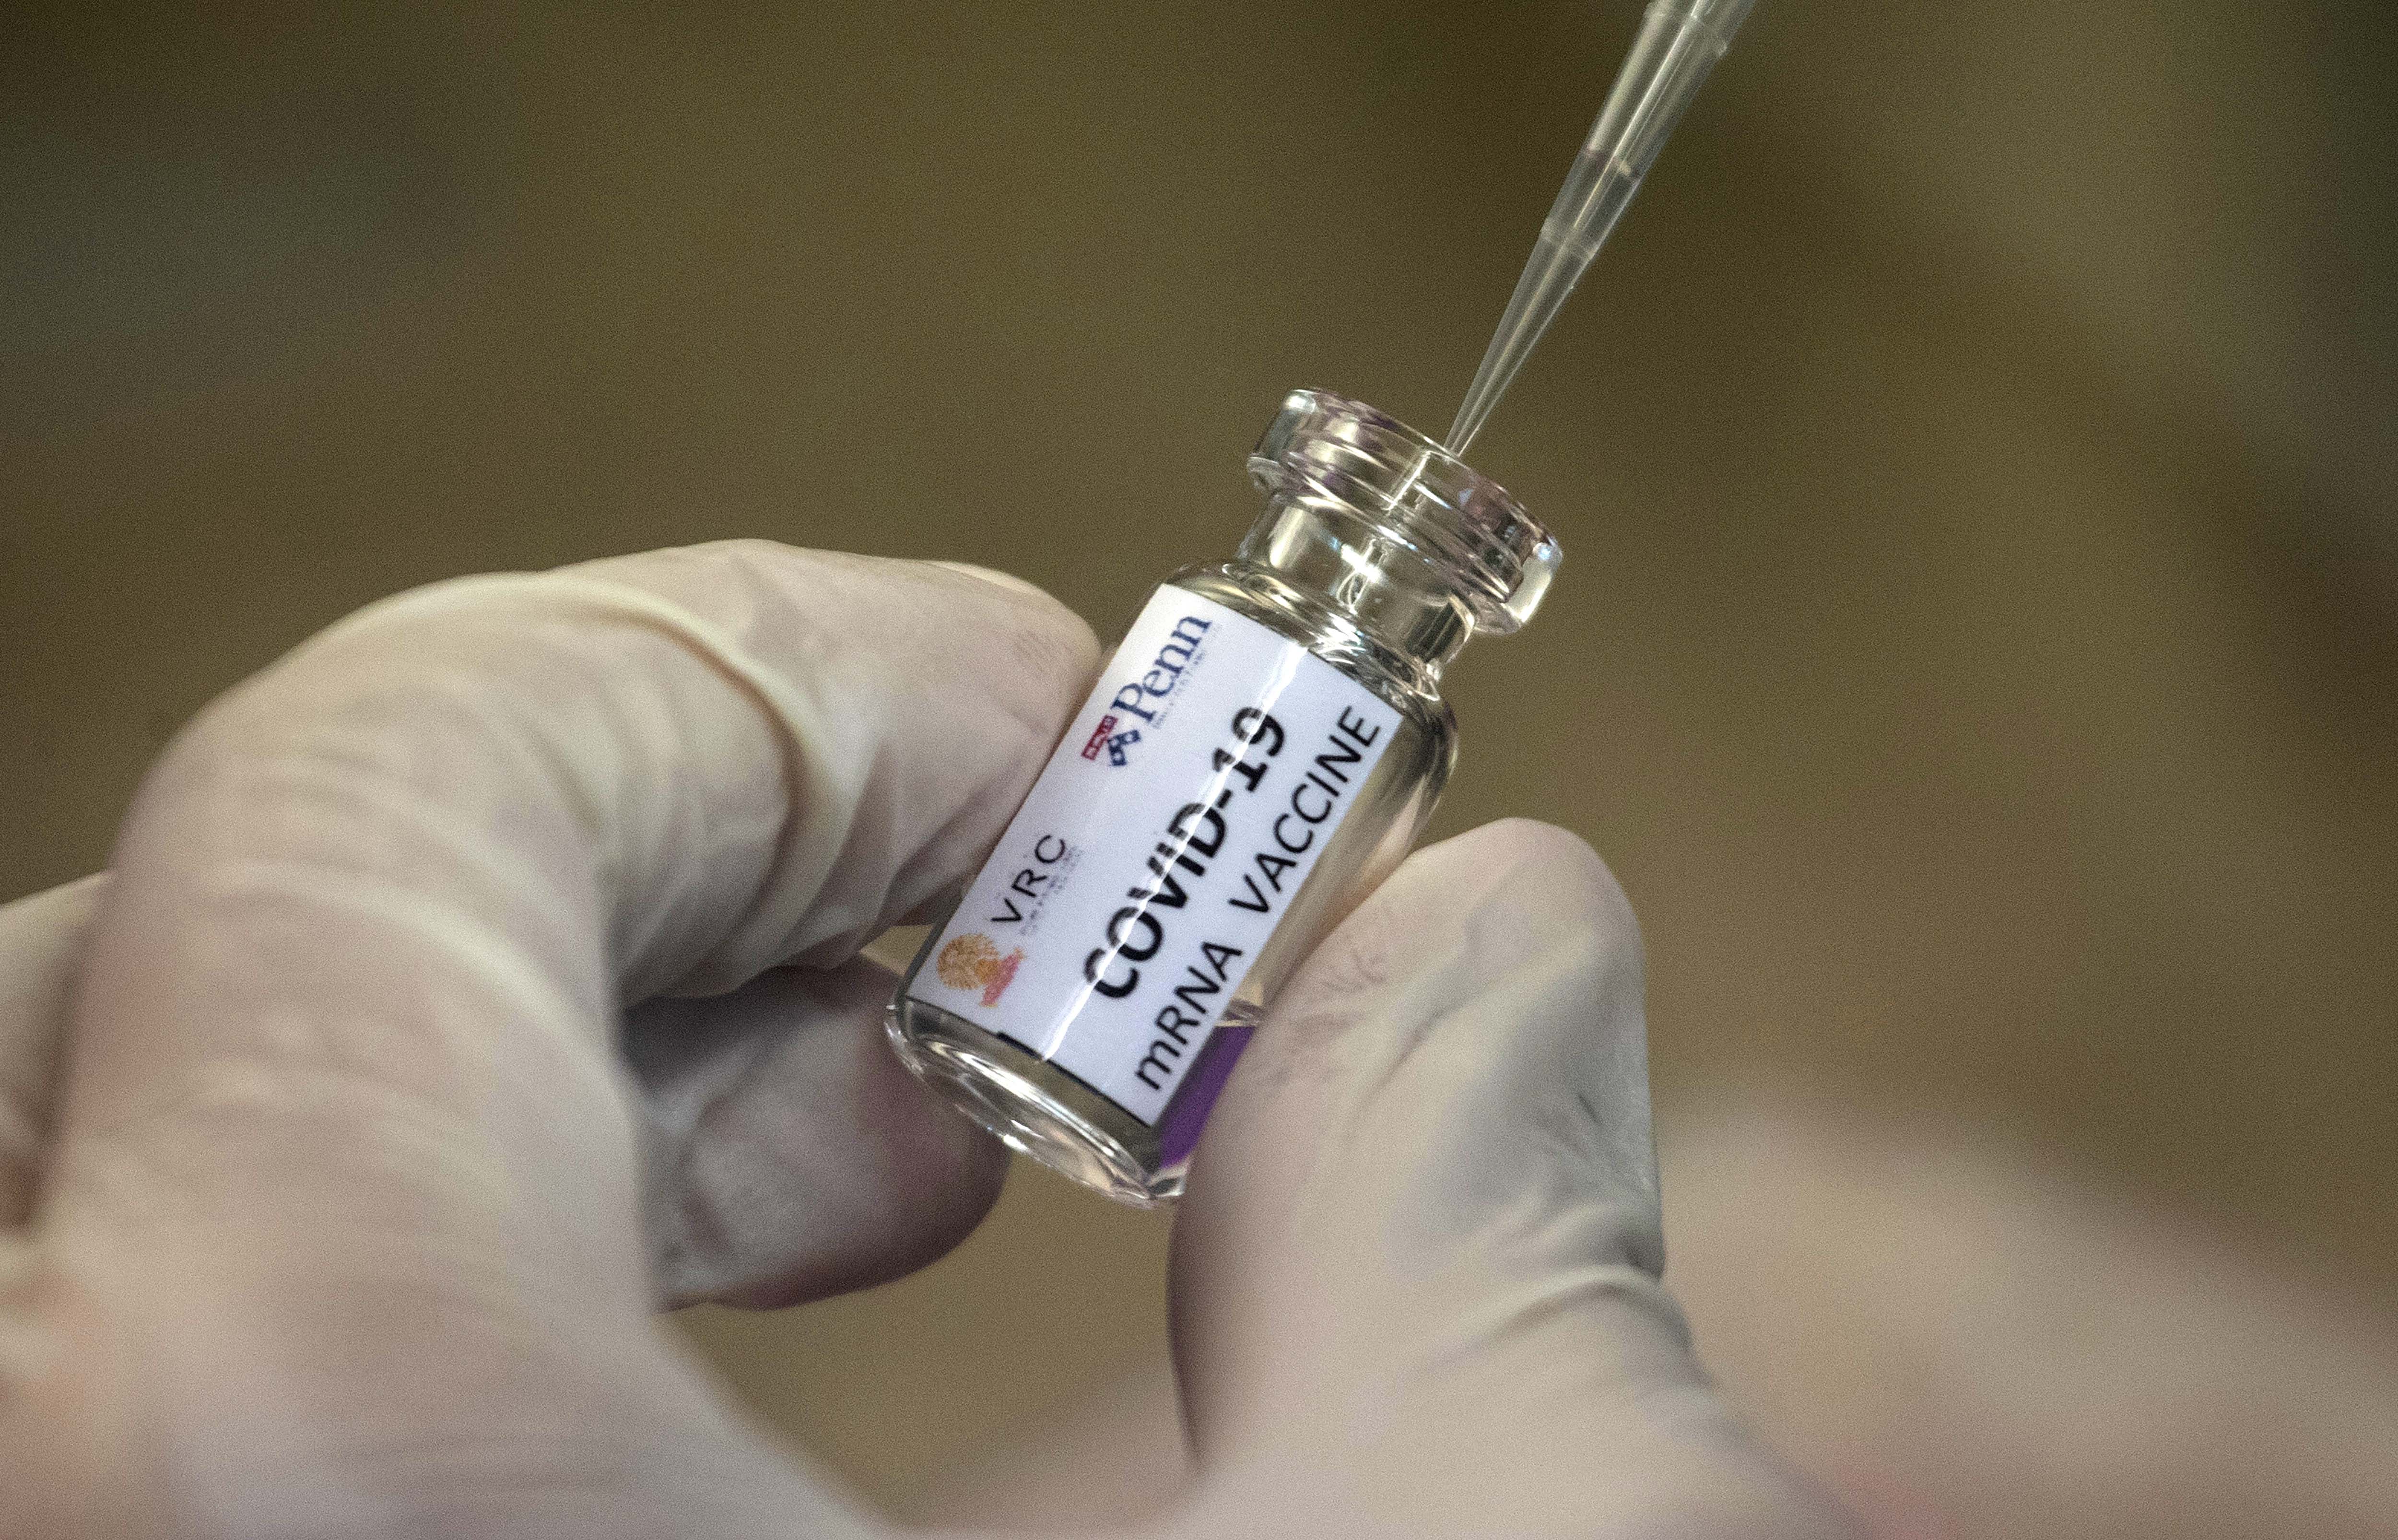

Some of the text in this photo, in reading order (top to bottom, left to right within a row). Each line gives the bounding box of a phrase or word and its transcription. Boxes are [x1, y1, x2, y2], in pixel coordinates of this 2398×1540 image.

[1110, 616, 1212, 722] Penn
[990, 835, 1065, 922] VRC
[1083, 706, 1286, 1000] COVID-19
[1135, 706, 1381, 1091] mRNA VACCINE
